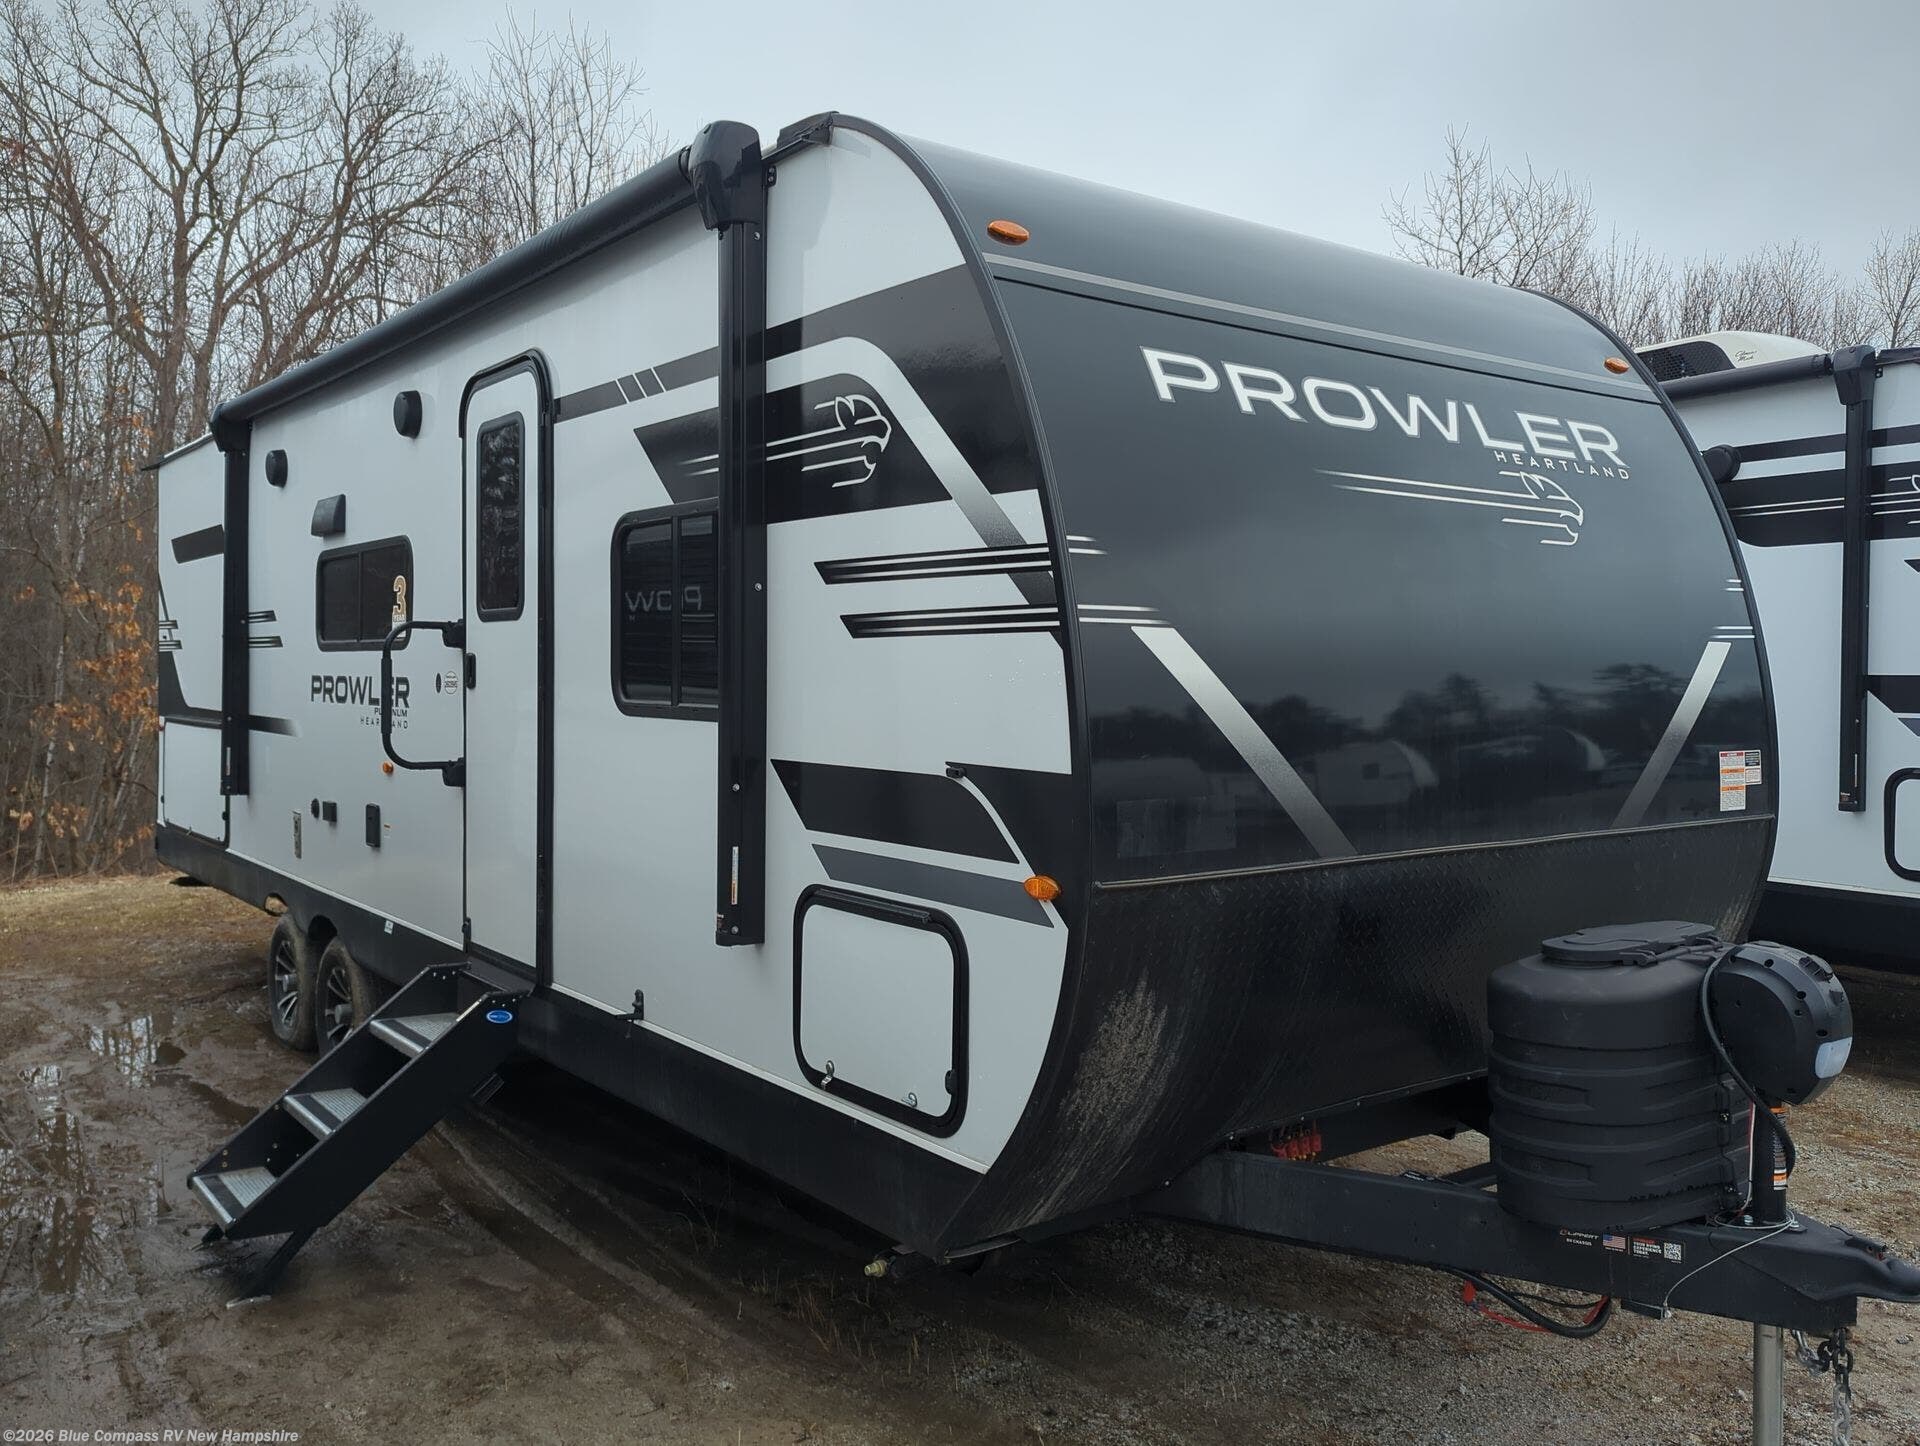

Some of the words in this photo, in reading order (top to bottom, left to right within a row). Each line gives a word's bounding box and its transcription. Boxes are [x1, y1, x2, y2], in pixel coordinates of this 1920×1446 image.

[1140, 346, 1629, 467] PROWLER
[1494, 450, 1630, 480] HEARTLAND
[392, 574, 407, 617] 3
[311, 674, 410, 708] PROWLR
[360, 717, 409, 729] HEARAND
